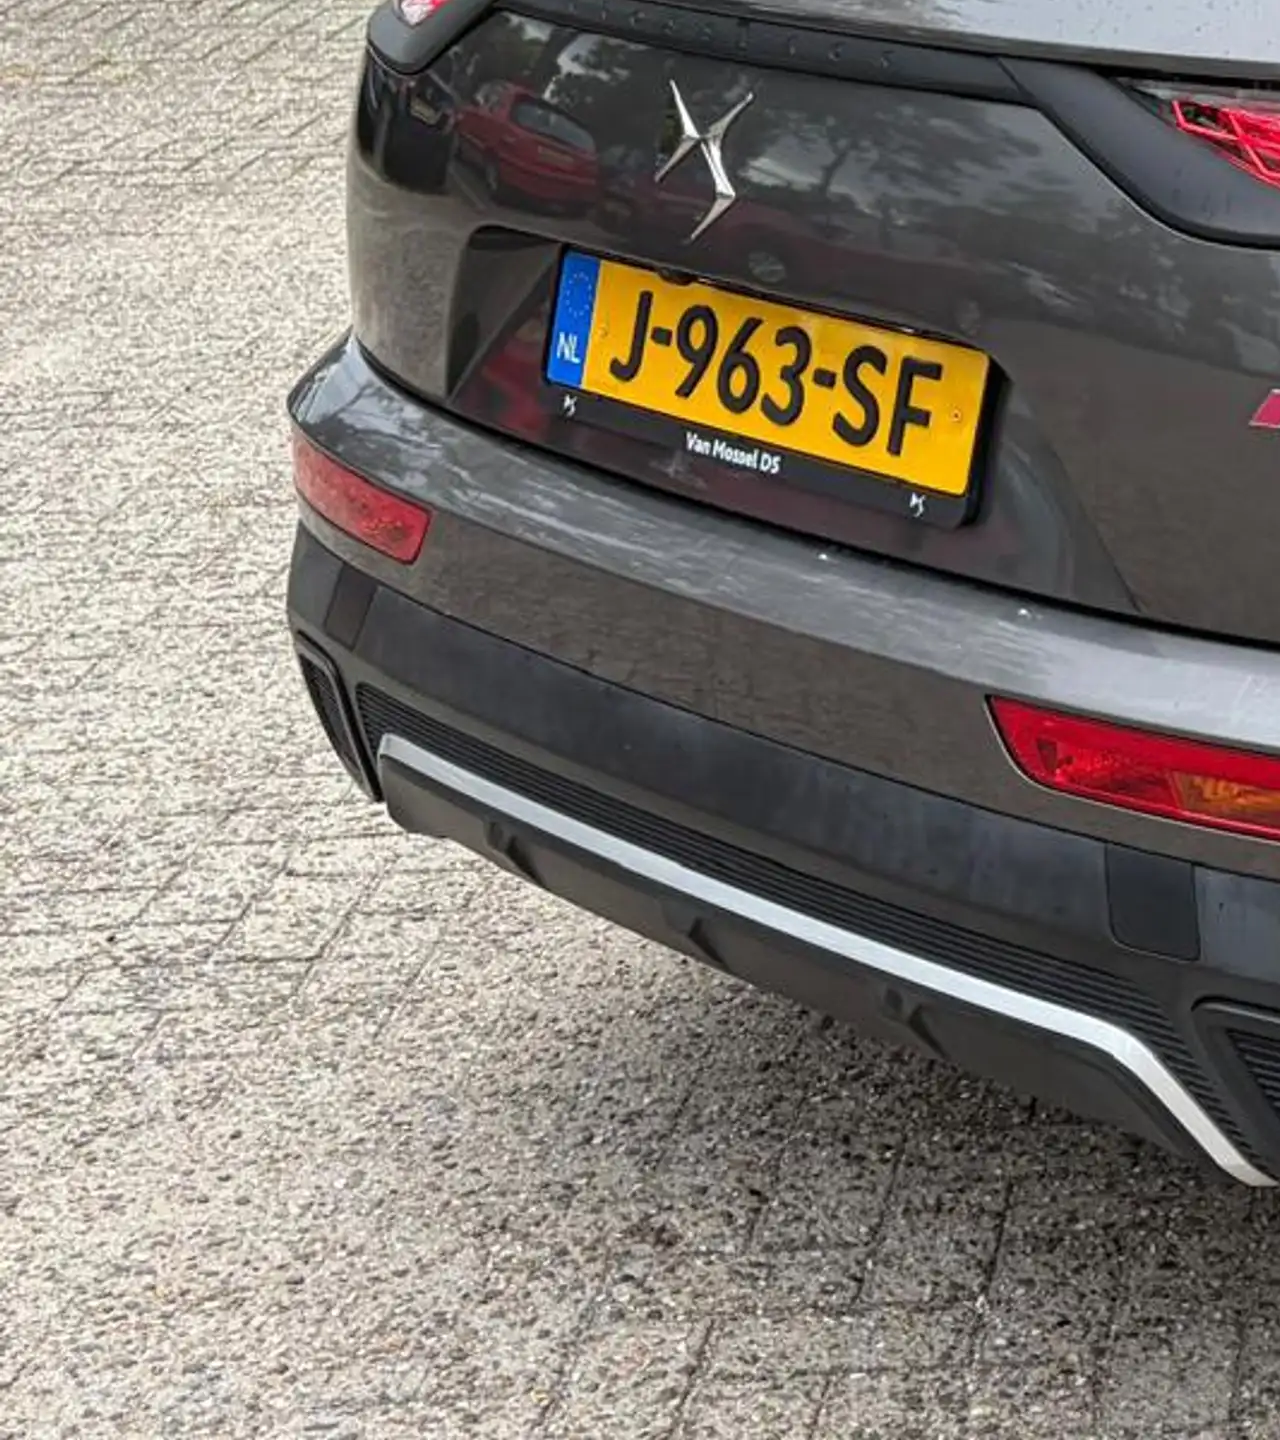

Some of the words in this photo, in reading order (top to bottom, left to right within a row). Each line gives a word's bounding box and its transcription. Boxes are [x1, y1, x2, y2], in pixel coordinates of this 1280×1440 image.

[556, 331, 581, 365] NL
[609, 290, 943, 457] J-963-SF
[686, 431, 712, 456] Van
[760, 452, 782, 474] DS
